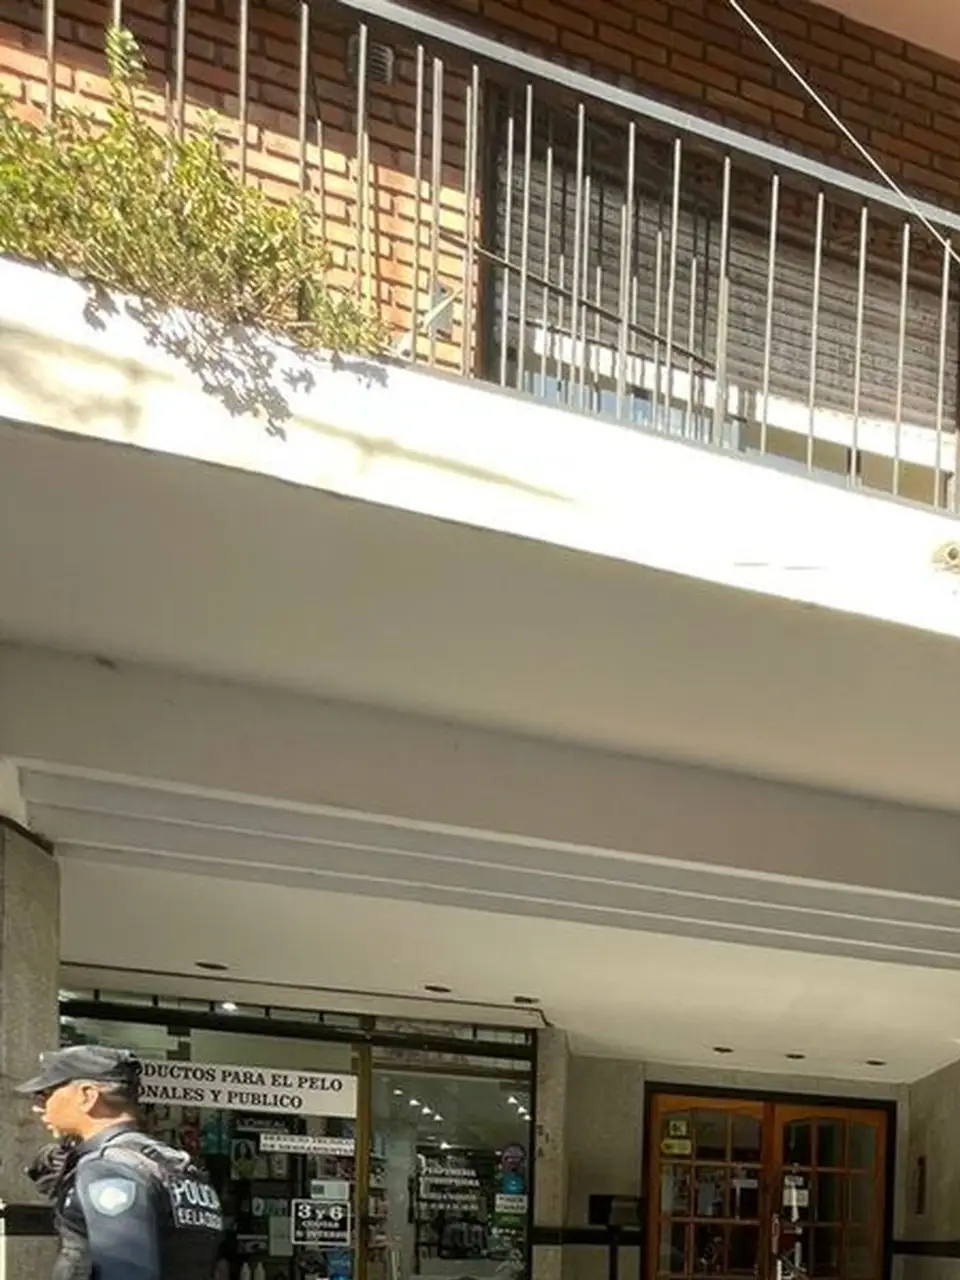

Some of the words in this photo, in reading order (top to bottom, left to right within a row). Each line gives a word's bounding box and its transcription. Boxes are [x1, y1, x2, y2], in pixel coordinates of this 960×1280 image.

[221, 1069, 266, 1087] PARA
[271, 1074, 294, 1089] EL
[297, 1076, 343, 1092] PELO
[210, 1088, 224, 1102] Y
[227, 1090, 304, 1110] PUBLICO
[297, 1203, 311, 1219] 3
[329, 1204, 344, 1221] 6
